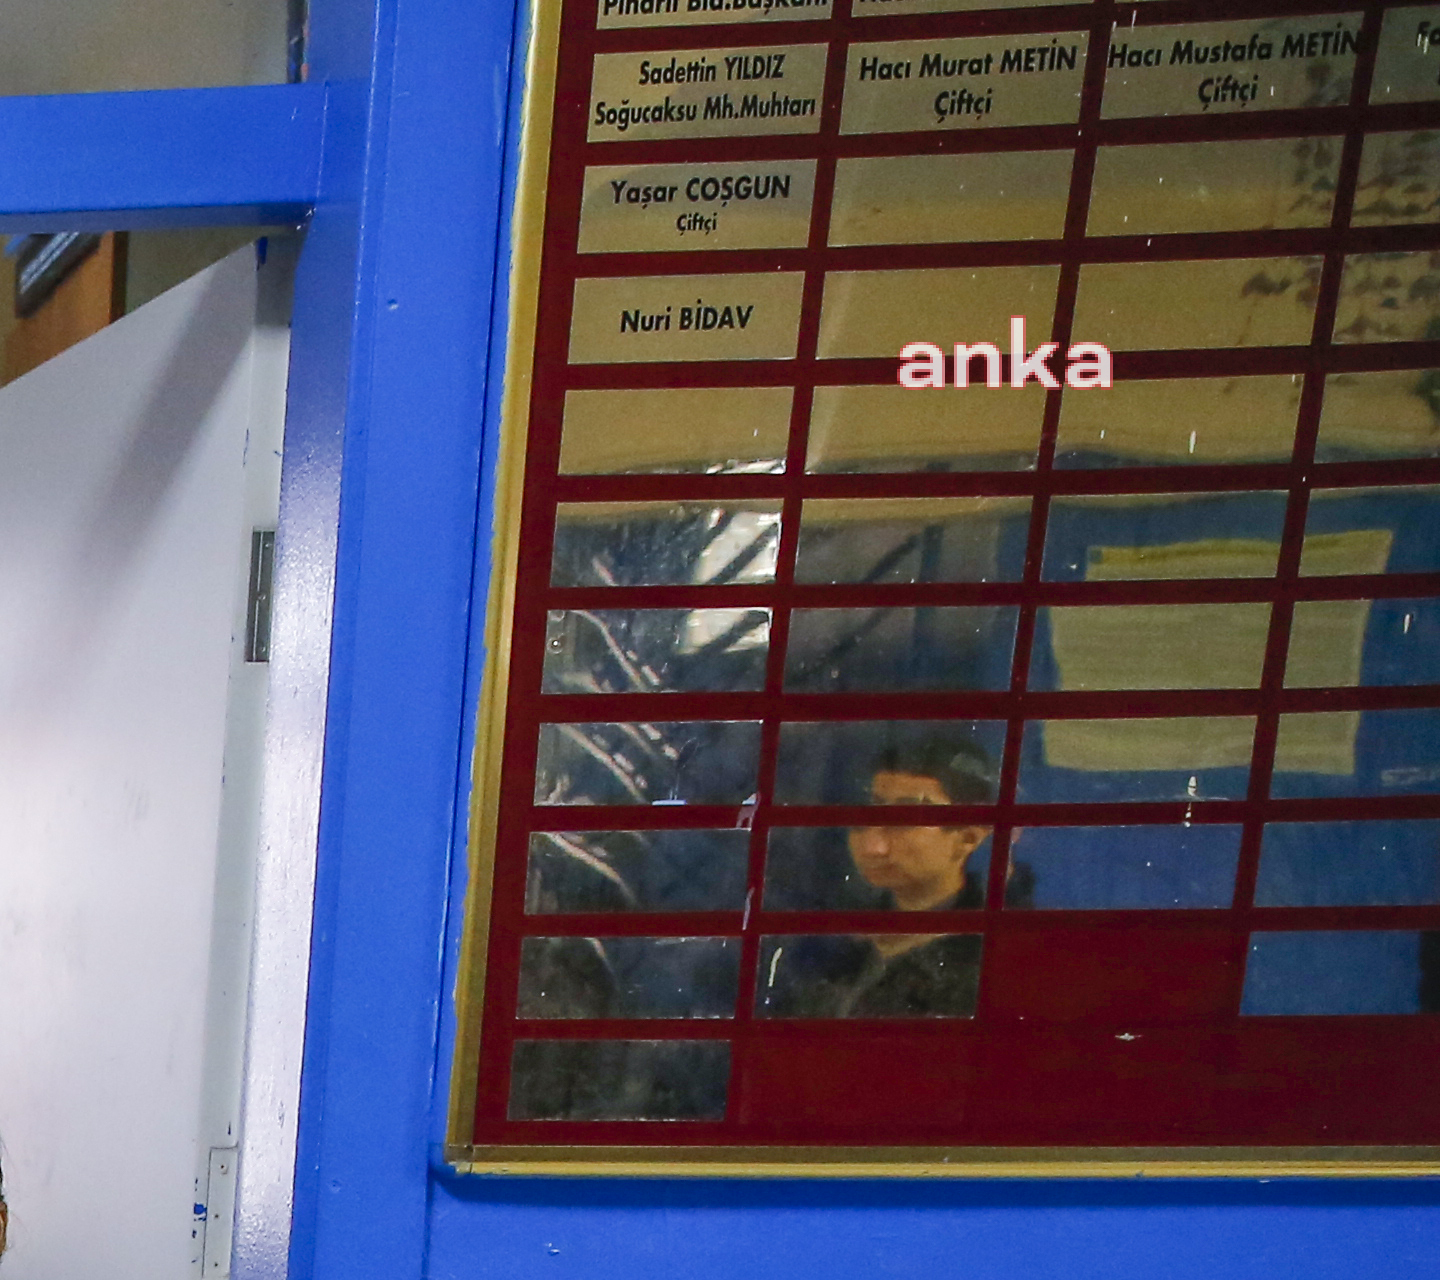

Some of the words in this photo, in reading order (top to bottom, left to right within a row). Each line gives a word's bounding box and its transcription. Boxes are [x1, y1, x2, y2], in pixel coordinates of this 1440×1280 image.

[859, 56, 911, 80] Hacı
[919, 53, 993, 78] Murat
[1000, 37, 1078, 73] METİN
[1107, 43, 1162, 68] Hacı
[1169, 33, 1273, 65] Mustafa
[1281, 22, 1361, 59] METİN
[638, 58, 716, 85] Sadettin
[724, 54, 786, 80] YILDIZ
[594, 96, 697, 130] Soğucaksu
[703, 92, 815, 120] Mh.Muhtarı
[934, 87, 993, 123] Çiftçi
[1198, 74, 1259, 112] Çiftçi
[610, 180, 678, 209] Yaşar
[684, 174, 792, 206] COŞGUN
[676, 213, 717, 236] Çiftçi
[620, 307, 672, 334] Nuri
[678, 298, 754, 331] BİDAV
